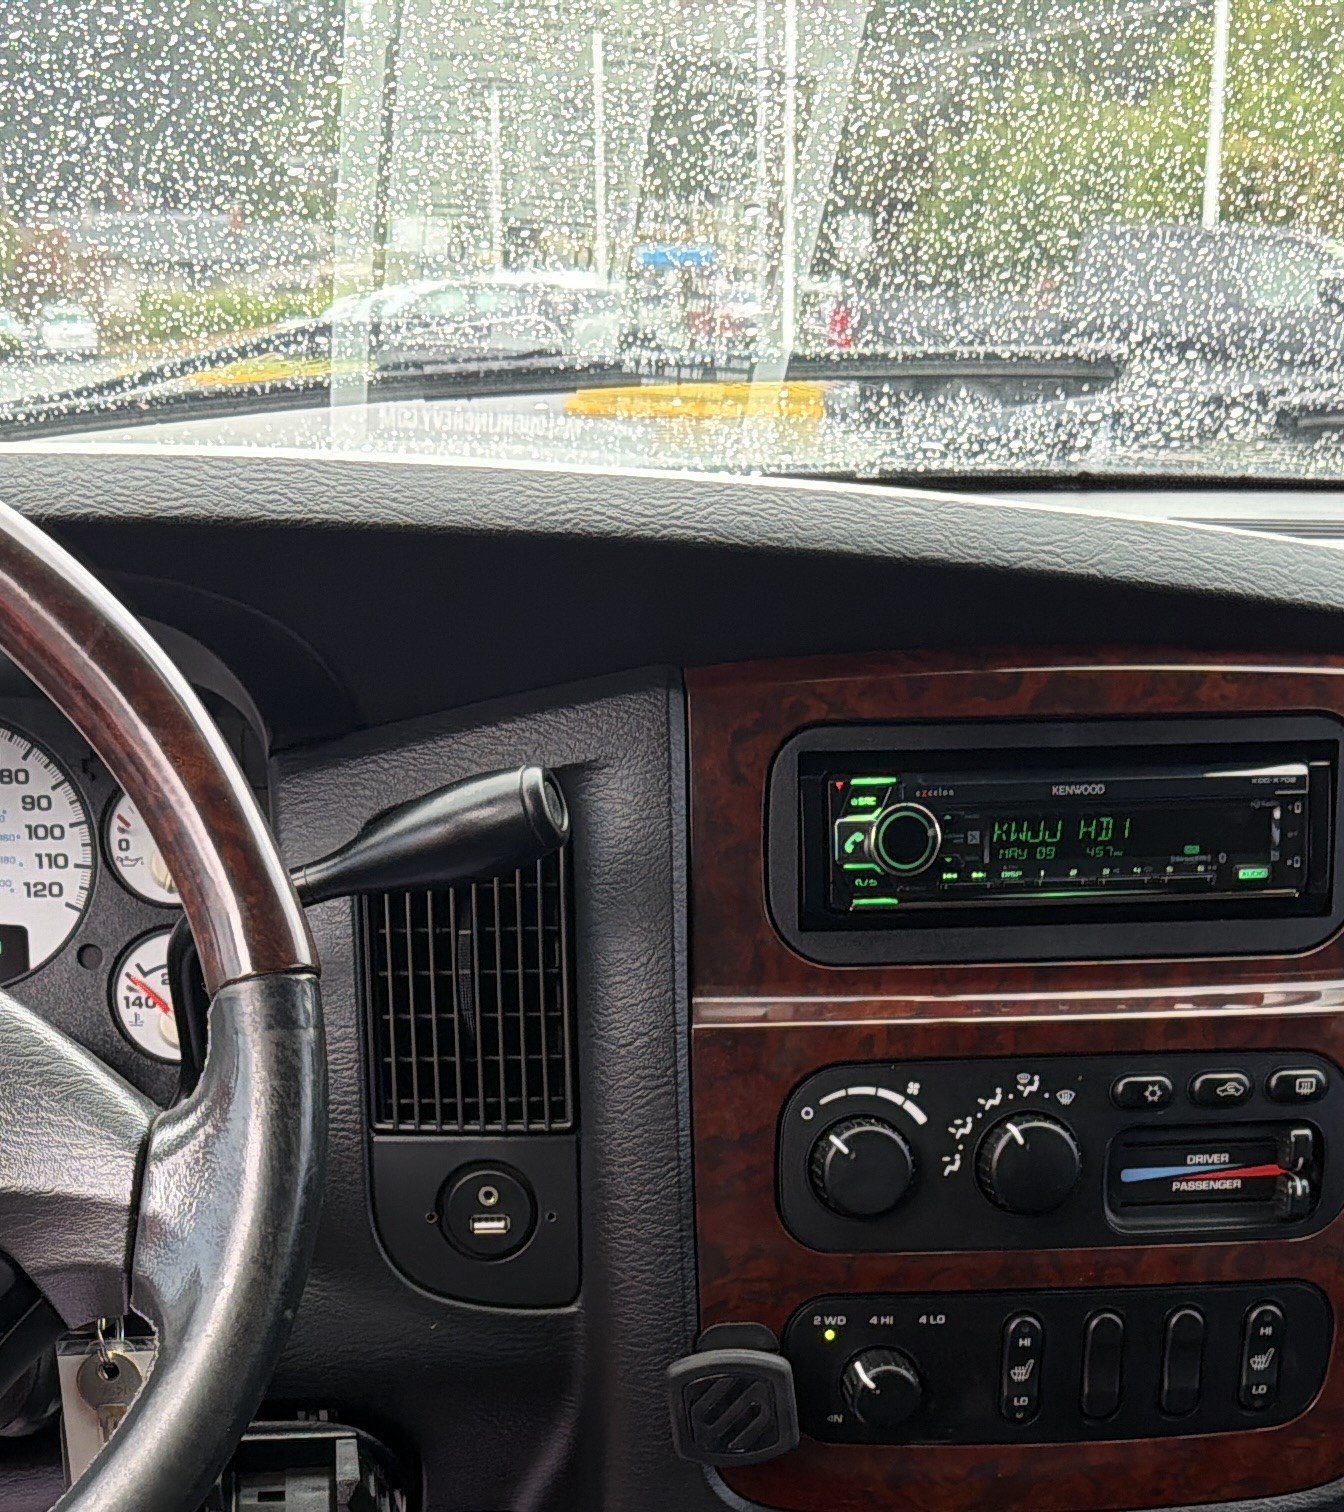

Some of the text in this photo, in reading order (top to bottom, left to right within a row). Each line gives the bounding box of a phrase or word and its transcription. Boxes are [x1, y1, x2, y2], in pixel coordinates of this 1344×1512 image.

[1051, 784, 1106, 796] KENWOOD
[21, 794, 52, 812] 90
[24, 823, 65, 841] 100
[118, 838, 131, 852] 0
[34, 852, 69, 870] 110
[22, 881, 64, 899] 120
[1186, 1153, 1230, 1165] DRIVER
[1172, 1179, 1242, 1192] PASSENGER
[813, 1315, 847, 1326] 2 WD
[869, 1315, 894, 1325] 4 HI
[918, 1314, 946, 1325] 4 LO
[1259, 1325, 1273, 1336] HI
[1018, 1337, 1032, 1347] HI
[1251, 1384, 1268, 1395] LO
[1013, 1396, 1029, 1407] LO
